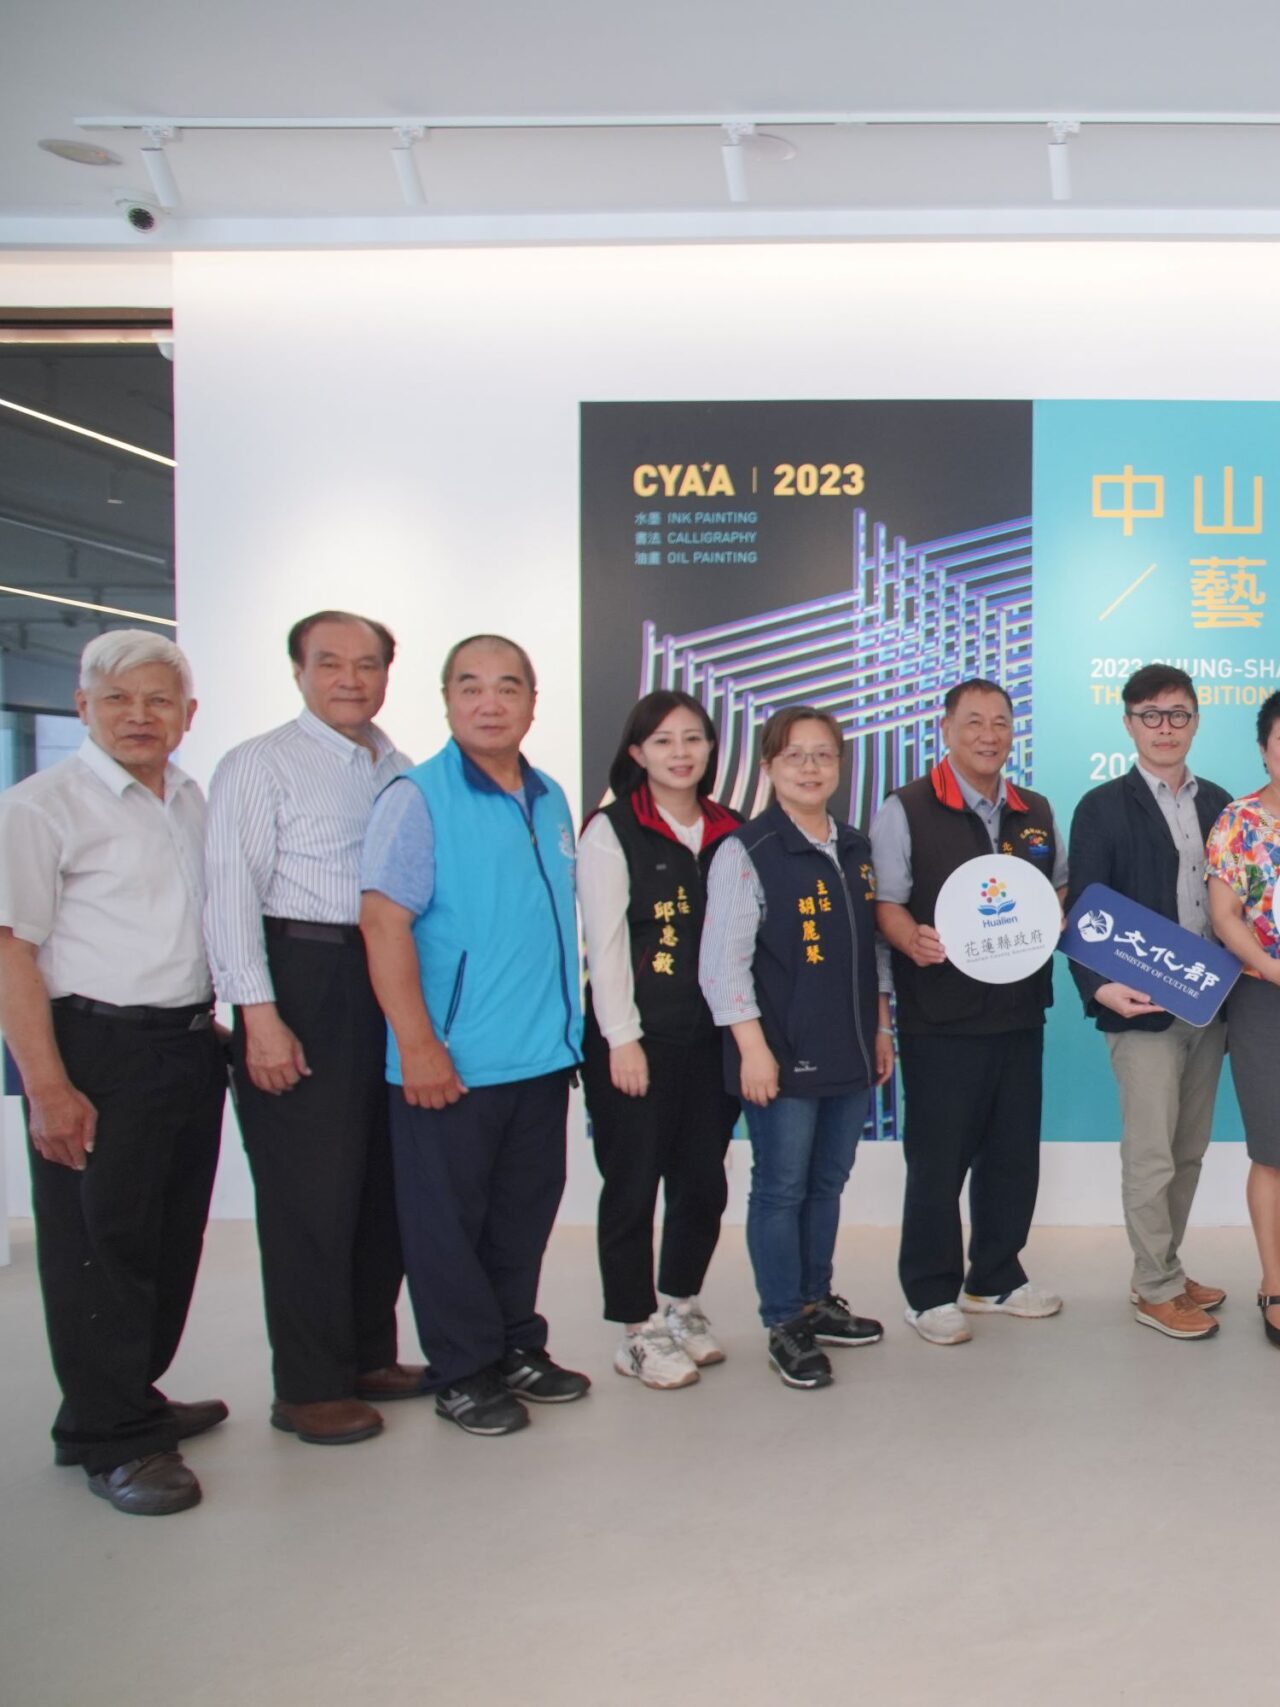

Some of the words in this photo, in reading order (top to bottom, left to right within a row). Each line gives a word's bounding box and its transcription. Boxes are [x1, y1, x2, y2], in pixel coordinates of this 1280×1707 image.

[633, 462, 736, 497] CYAA
[773, 463, 866, 496] 2023
[667, 511, 692, 524] INK
[694, 511, 758, 524] PAINTING
[667, 531, 758, 544] CALLIGRAPHY
[667, 551, 690, 564] OIL
[692, 551, 758, 564] PAINTING
[1091, 685, 1121, 705] TH
[1197, 685, 1277, 705] BITION
[982, 915, 1018, 929] Hualien
[964, 928, 1043, 957] 花蓮縣政府
[1113, 930, 1221, 992] 文化部
[1113, 948, 1152, 973] MINISTRY
[1151, 968, 1164, 979] OF
[1162, 975, 1200, 999] CULTURE
